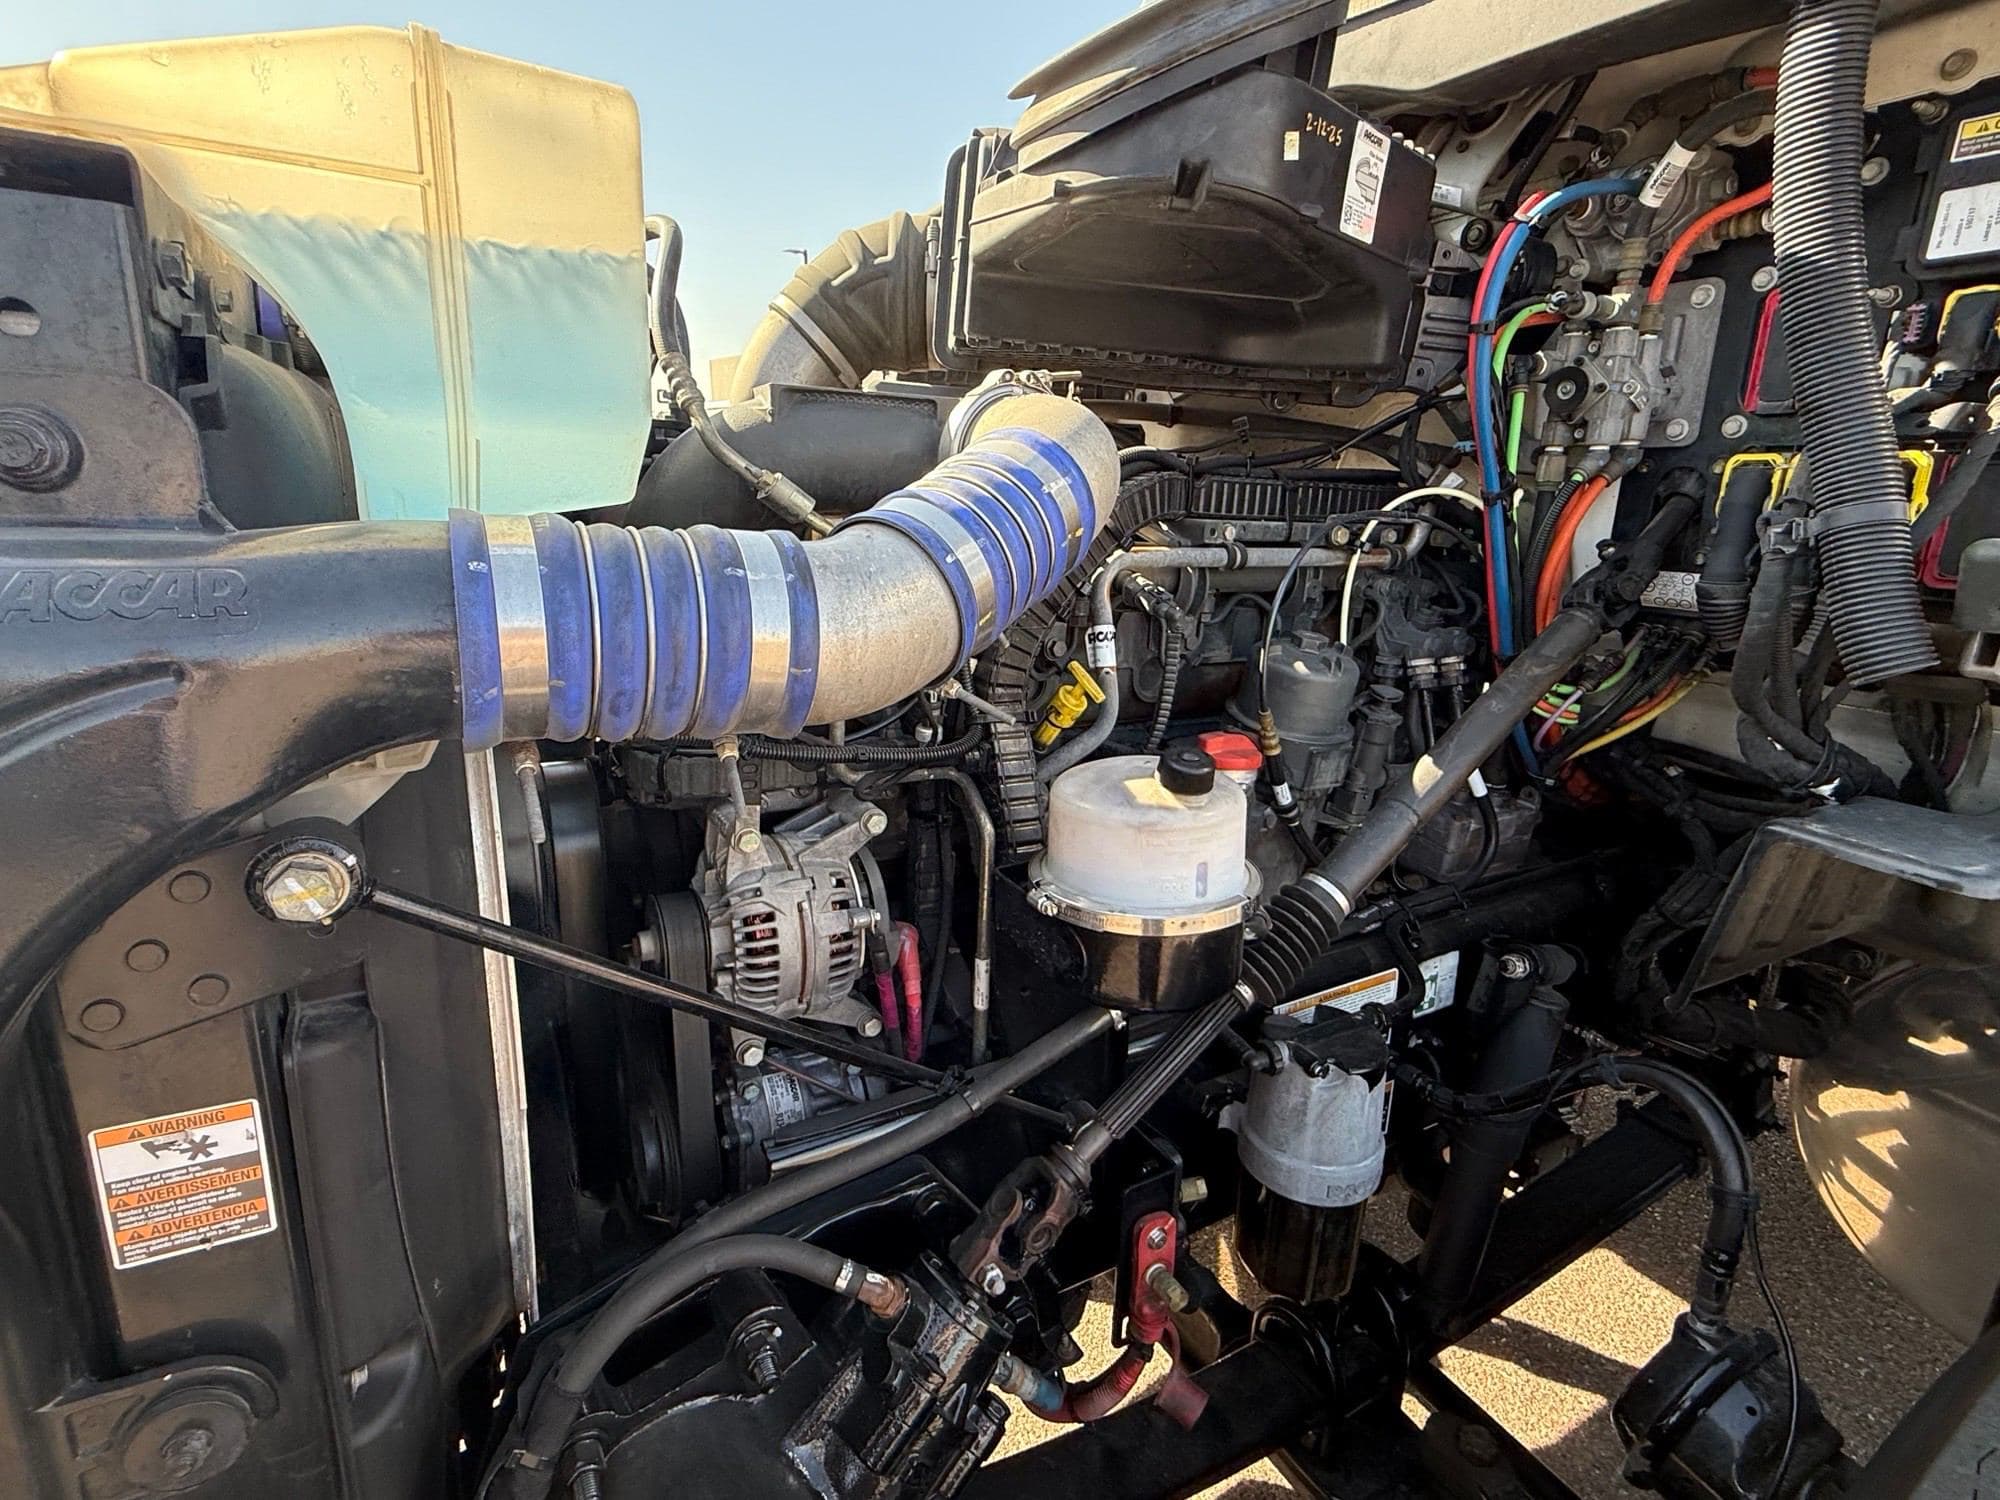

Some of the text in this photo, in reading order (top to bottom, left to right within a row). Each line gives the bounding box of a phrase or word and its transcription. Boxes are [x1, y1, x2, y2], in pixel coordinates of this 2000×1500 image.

[148, 1110, 226, 1134] WARNING
[110, 1180, 131, 1190] Keep
[132, 1176, 151, 1184] clear
[162, 1169, 187, 1178] engine
[136, 1167, 260, 1204] AVERTISSEMENT
[165, 1174, 194, 1182] without
[150, 1201, 258, 1236] ADVERTENCIA
